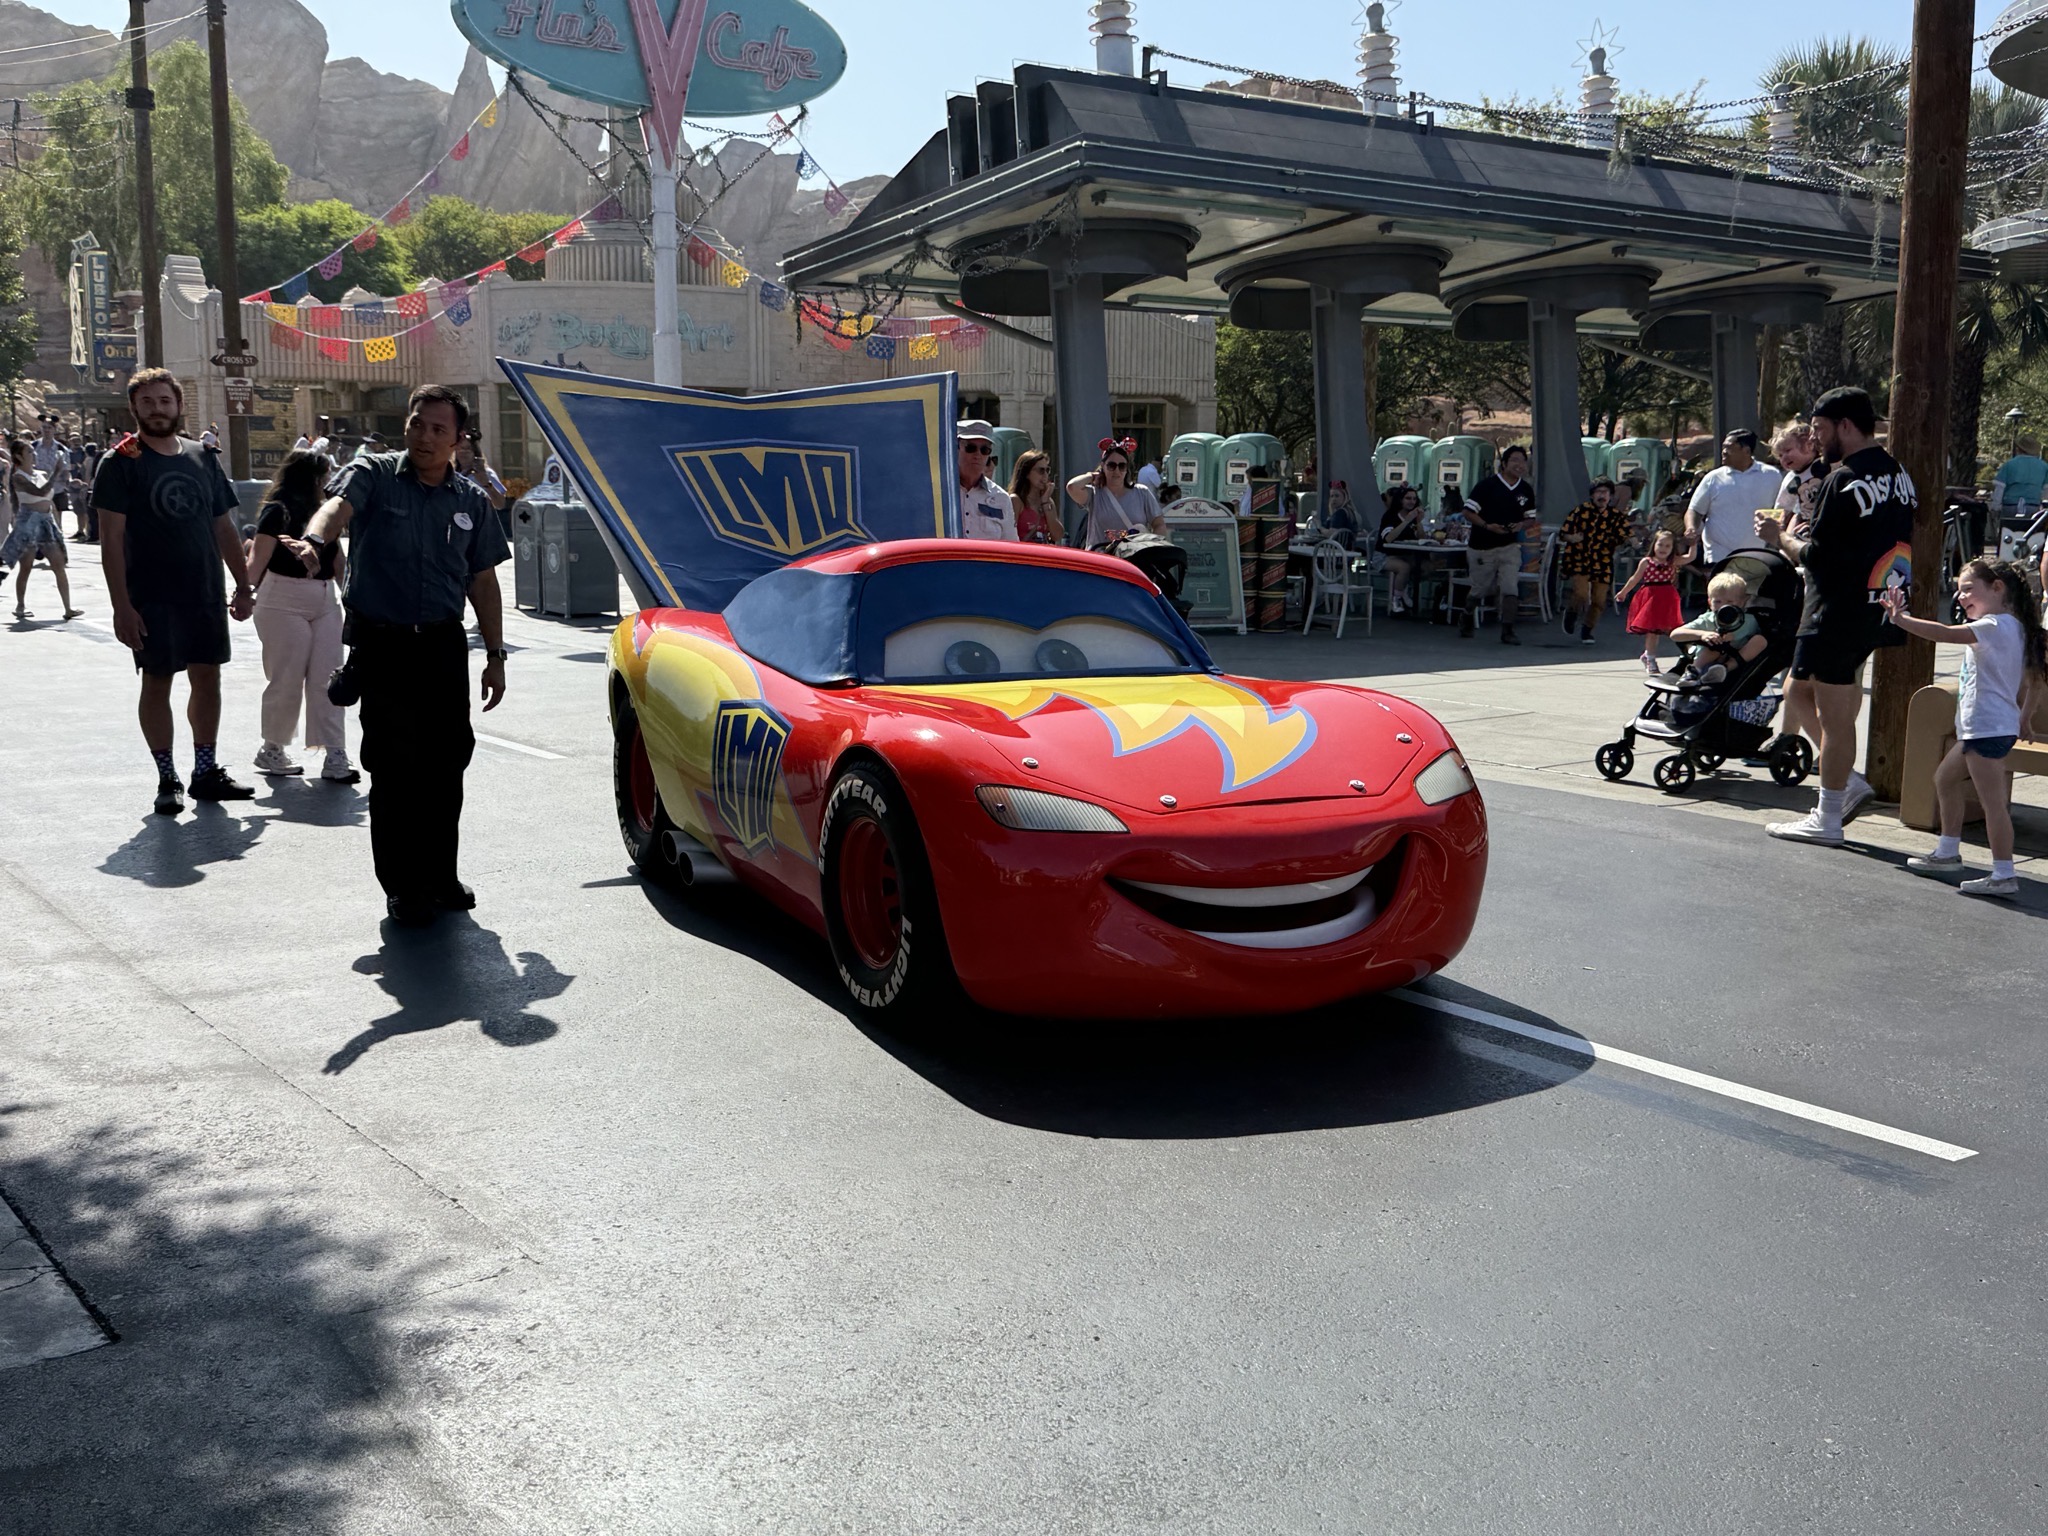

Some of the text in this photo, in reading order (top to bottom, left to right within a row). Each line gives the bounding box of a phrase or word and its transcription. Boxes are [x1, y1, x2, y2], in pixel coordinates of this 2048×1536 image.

[706, 10, 824, 92] Cafe
[222, 356, 244, 364] CROSS
[549, 310, 654, 361] Body
[818, 779, 887, 876] LIGHTYEAR
[839, 914, 912, 1008] LIGHTYEAR
